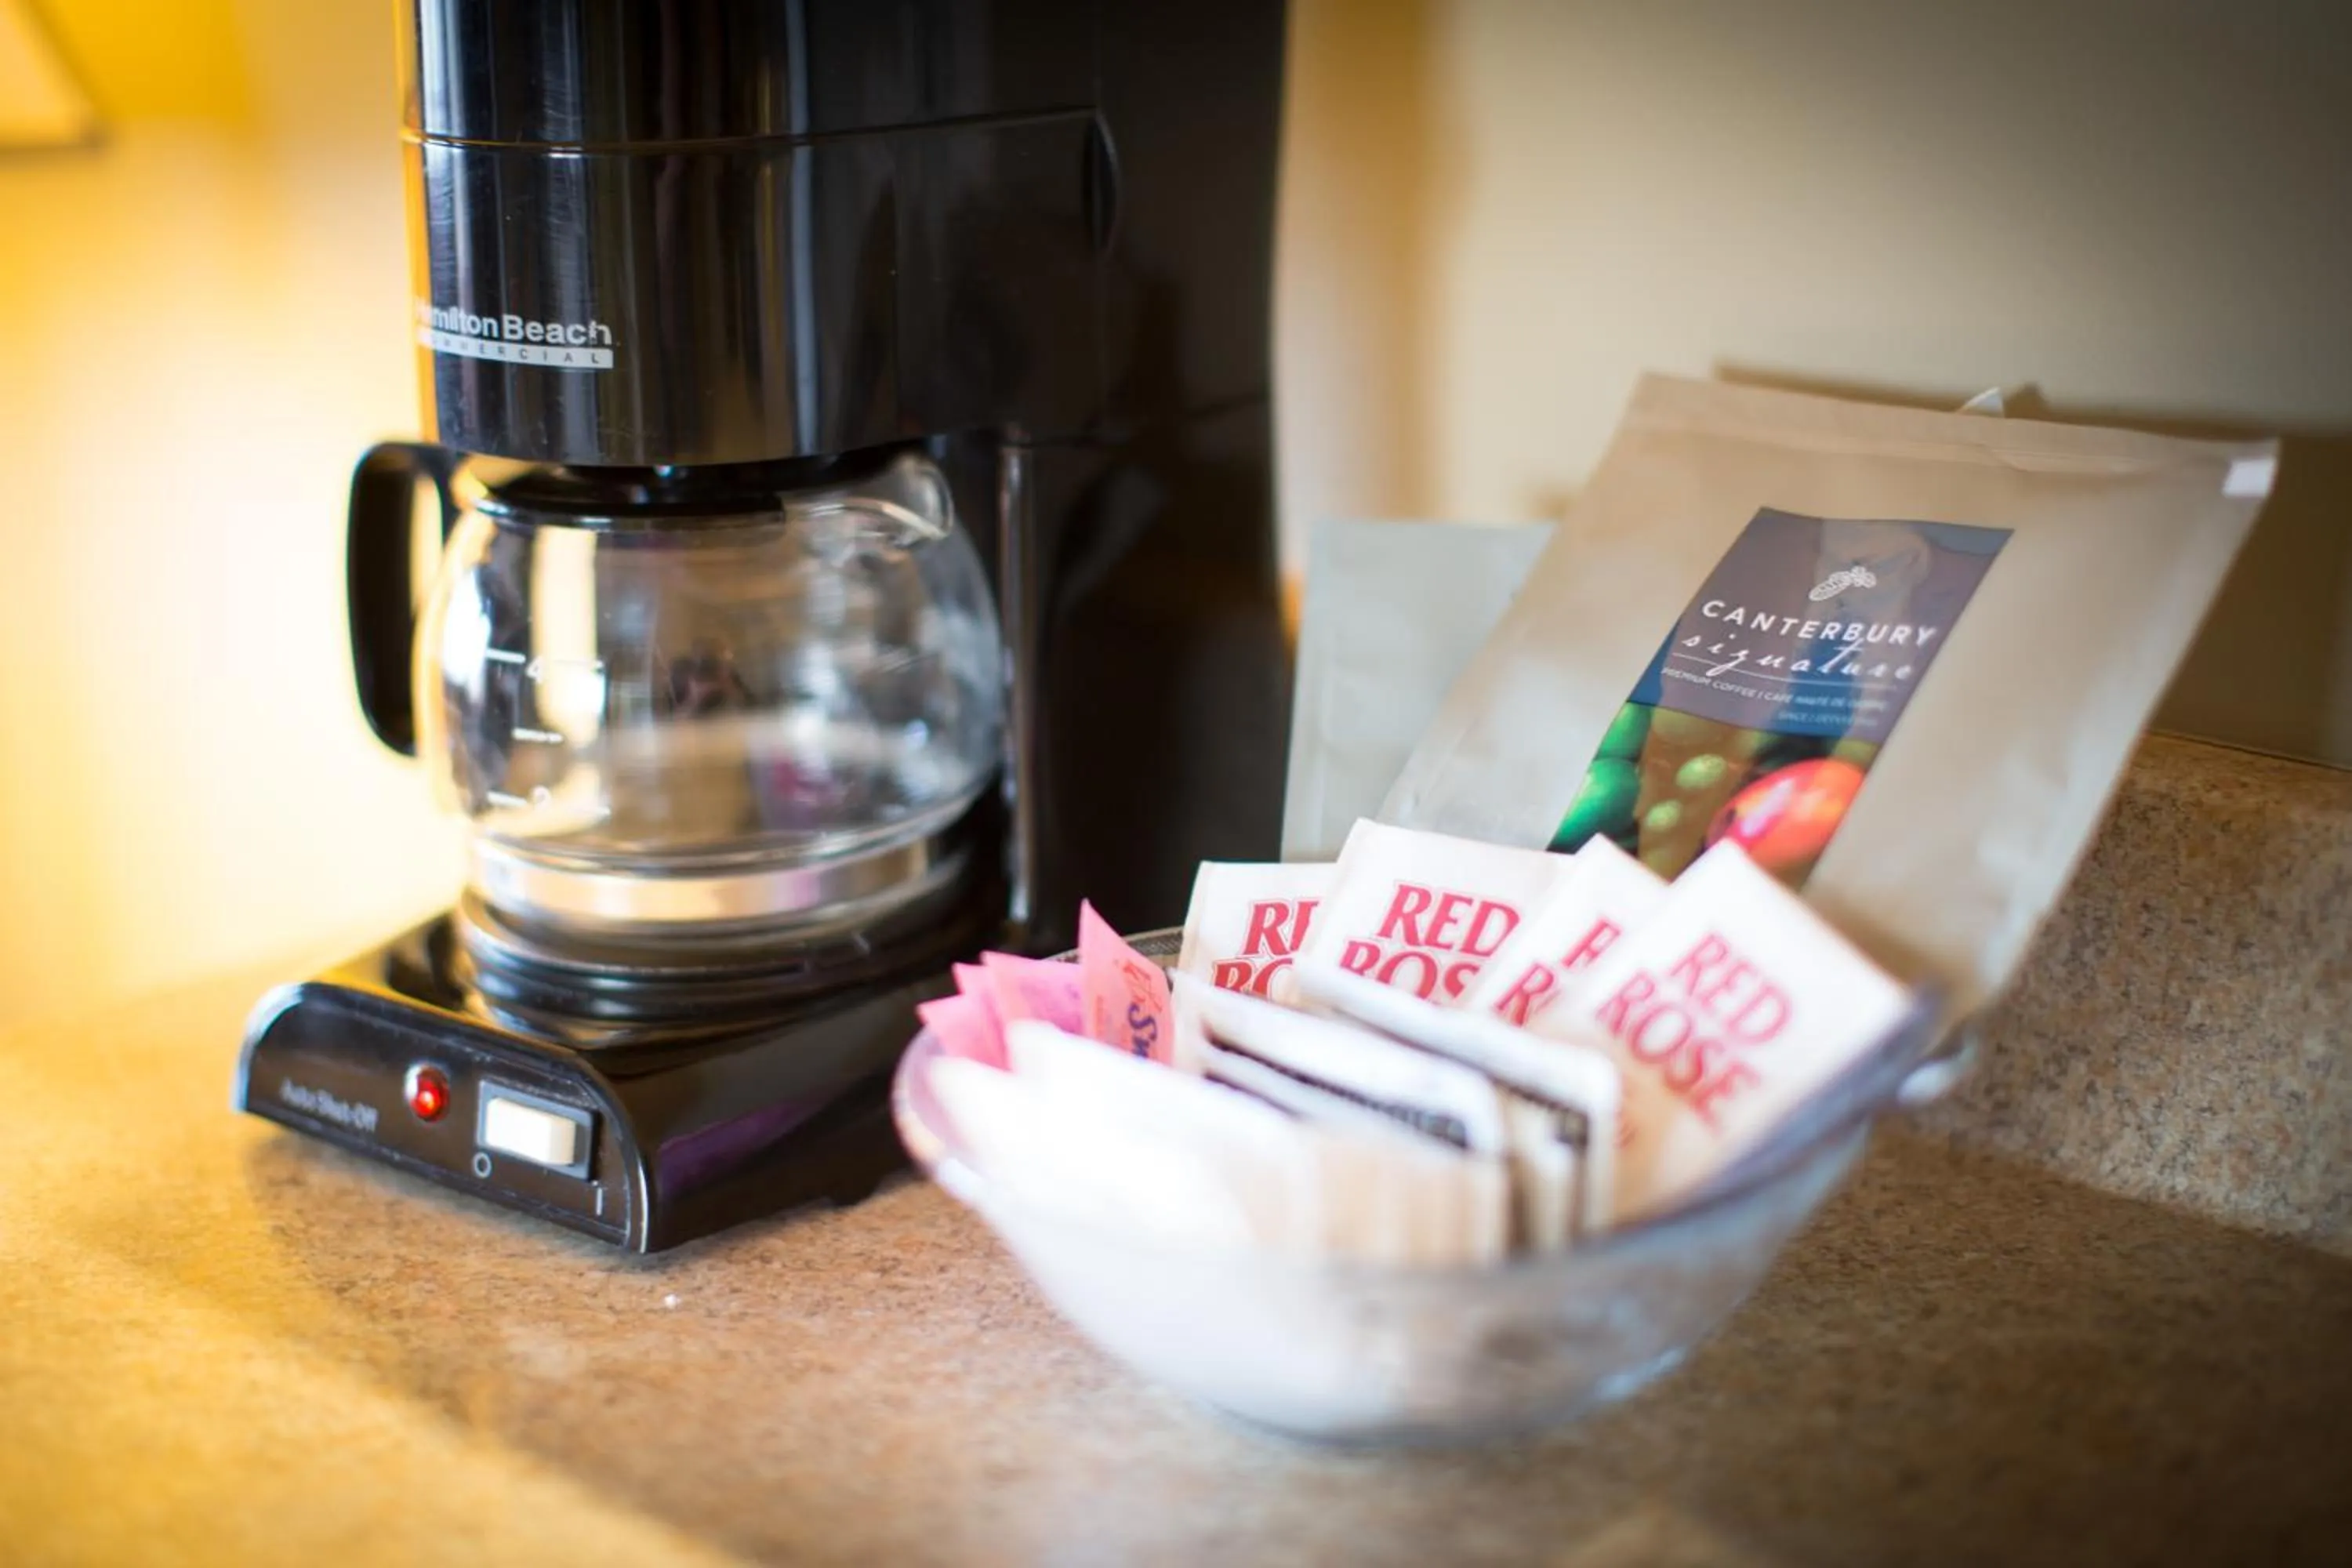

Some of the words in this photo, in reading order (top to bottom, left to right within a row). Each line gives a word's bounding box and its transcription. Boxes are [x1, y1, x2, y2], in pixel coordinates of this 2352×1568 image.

[503, 314, 613, 346] Beach
[1702, 600, 1936, 648] CANTERBURY
[1682, 633, 1911, 680] signature
[1712, 680, 1757, 699] COFFEE
[1377, 884, 1519, 957] RED
[1669, 931, 1792, 1047] RED
[1595, 967, 1761, 1135] ROSE
